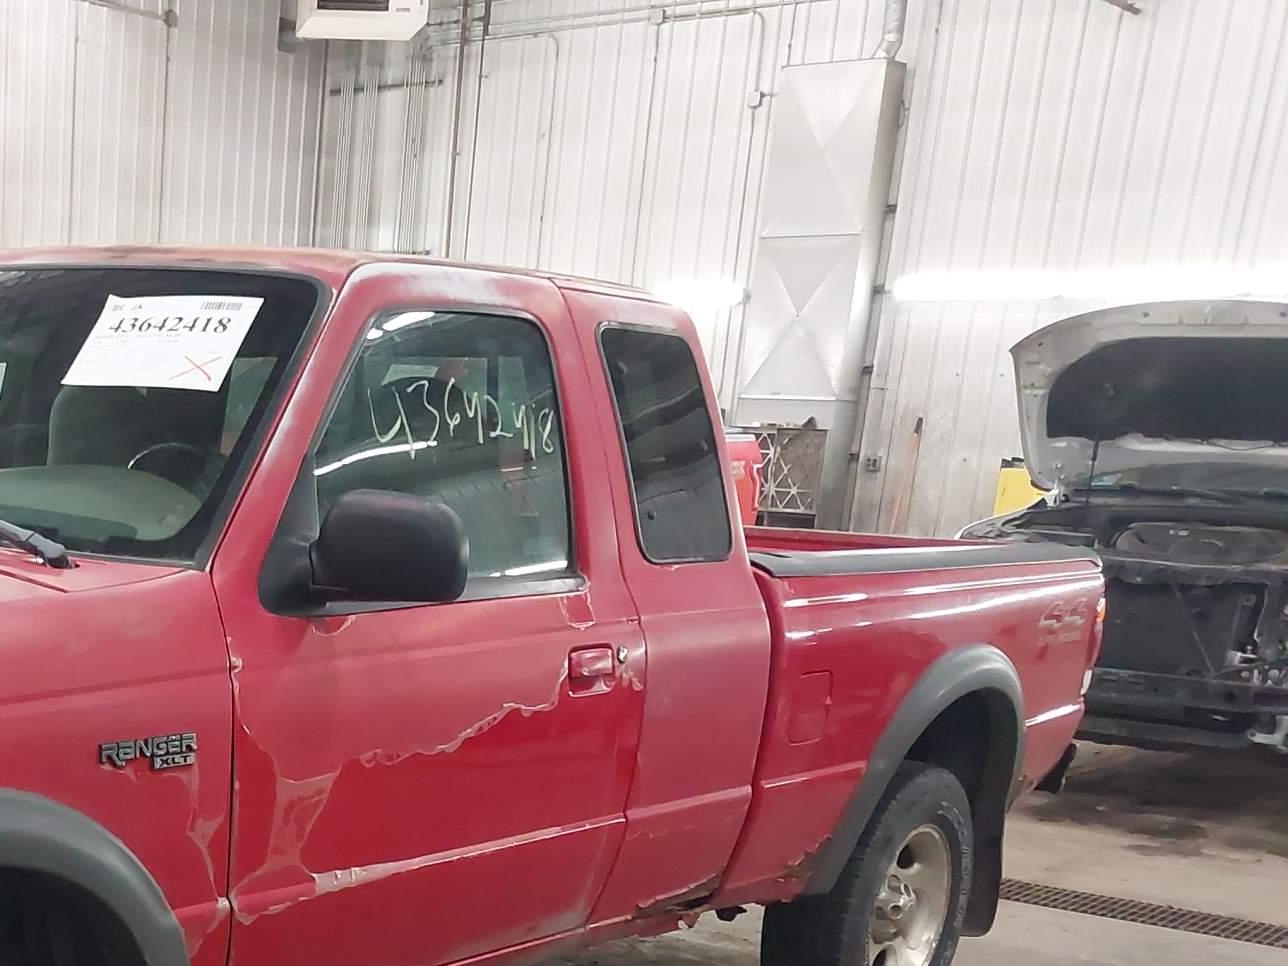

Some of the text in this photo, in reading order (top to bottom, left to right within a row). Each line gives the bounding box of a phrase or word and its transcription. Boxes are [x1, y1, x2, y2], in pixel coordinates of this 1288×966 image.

[109, 316, 232, 333] 43642418
[99, 732, 198, 768] RANGER
[157, 754, 193, 768] XLT
